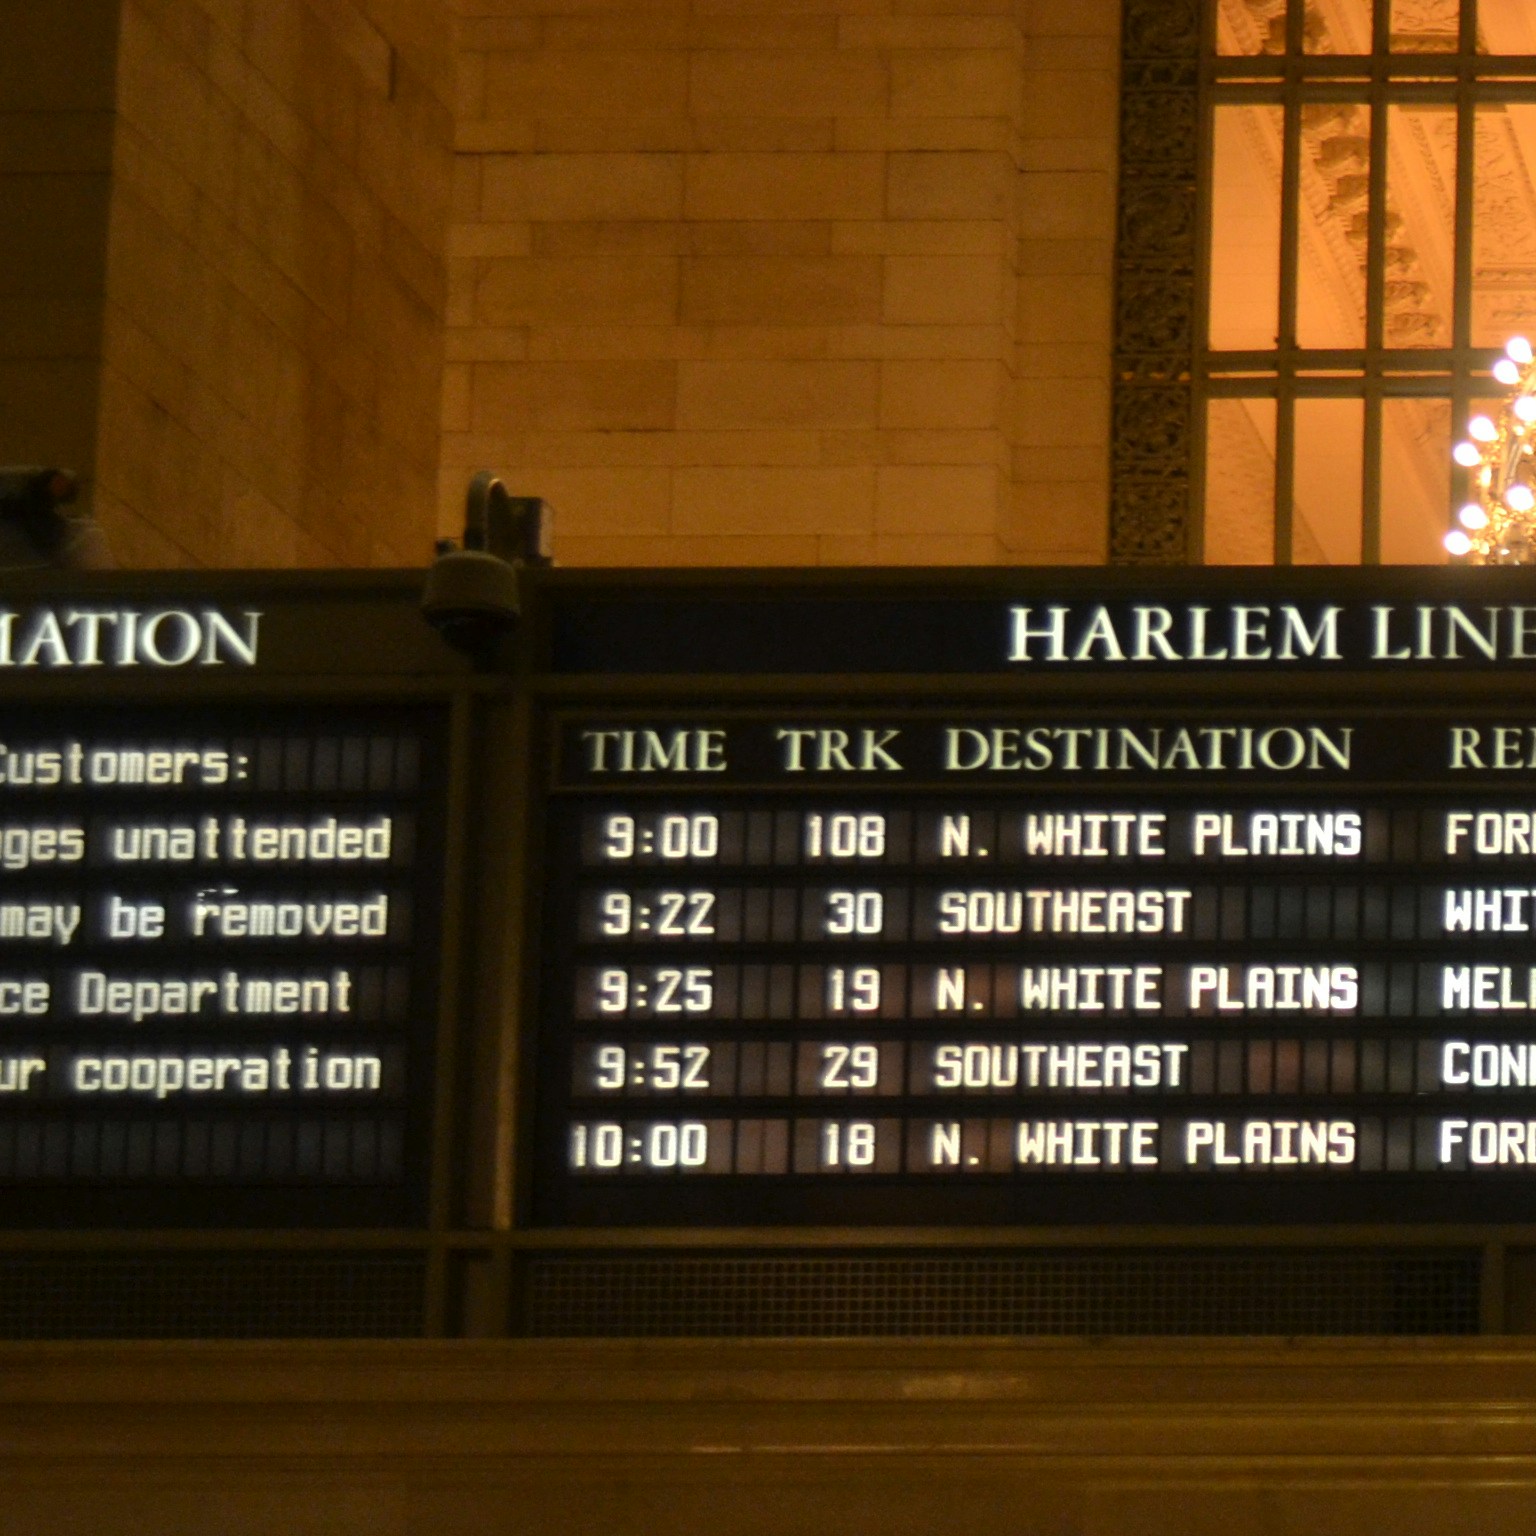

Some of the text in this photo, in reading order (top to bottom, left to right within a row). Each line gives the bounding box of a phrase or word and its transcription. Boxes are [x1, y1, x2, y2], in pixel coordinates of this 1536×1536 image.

[1007, 606, 1343, 661] HARLEM
[0, 743, 248, 785] ustomers:
[584, 730, 727, 772] TIME
[777, 728, 902, 771] TRK
[944, 727, 1354, 771] DESTINATION
[113, 818, 392, 861] unattended
[606, 815, 718, 858] 9:00
[808, 814, 885, 857] 108
[941, 815, 989, 856] N.
[1025, 813, 1166, 856] WHITE
[1193, 812, 1361, 856] PLAINS
[108, 896, 165, 938] be
[193, 895, 388, 937] removed
[602, 892, 715, 935] 9:22
[827, 892, 882, 934] 30
[939, 890, 1191, 933] SOUTHEAST
[78, 971, 352, 1022] Department
[598, 969, 712, 1013] 9:25
[830, 968, 880, 1012] 19
[935, 968, 984, 1010] N.
[1021, 966, 1162, 1010] WHITE
[1189, 965, 1358, 1011] PLAINS
[74, 1048, 381, 1099] cooperation
[596, 1046, 710, 1089] 9:52
[821, 1044, 878, 1089] 29
[934, 1044, 1188, 1088] SOUTHEAST
[574, 1123, 707, 1167] 10:00
[825, 1122, 875, 1167] 18
[932, 1123, 981, 1165] N.
[1017, 1121, 1158, 1165] WHITE
[1185, 1120, 1355, 1165] PLAINS
